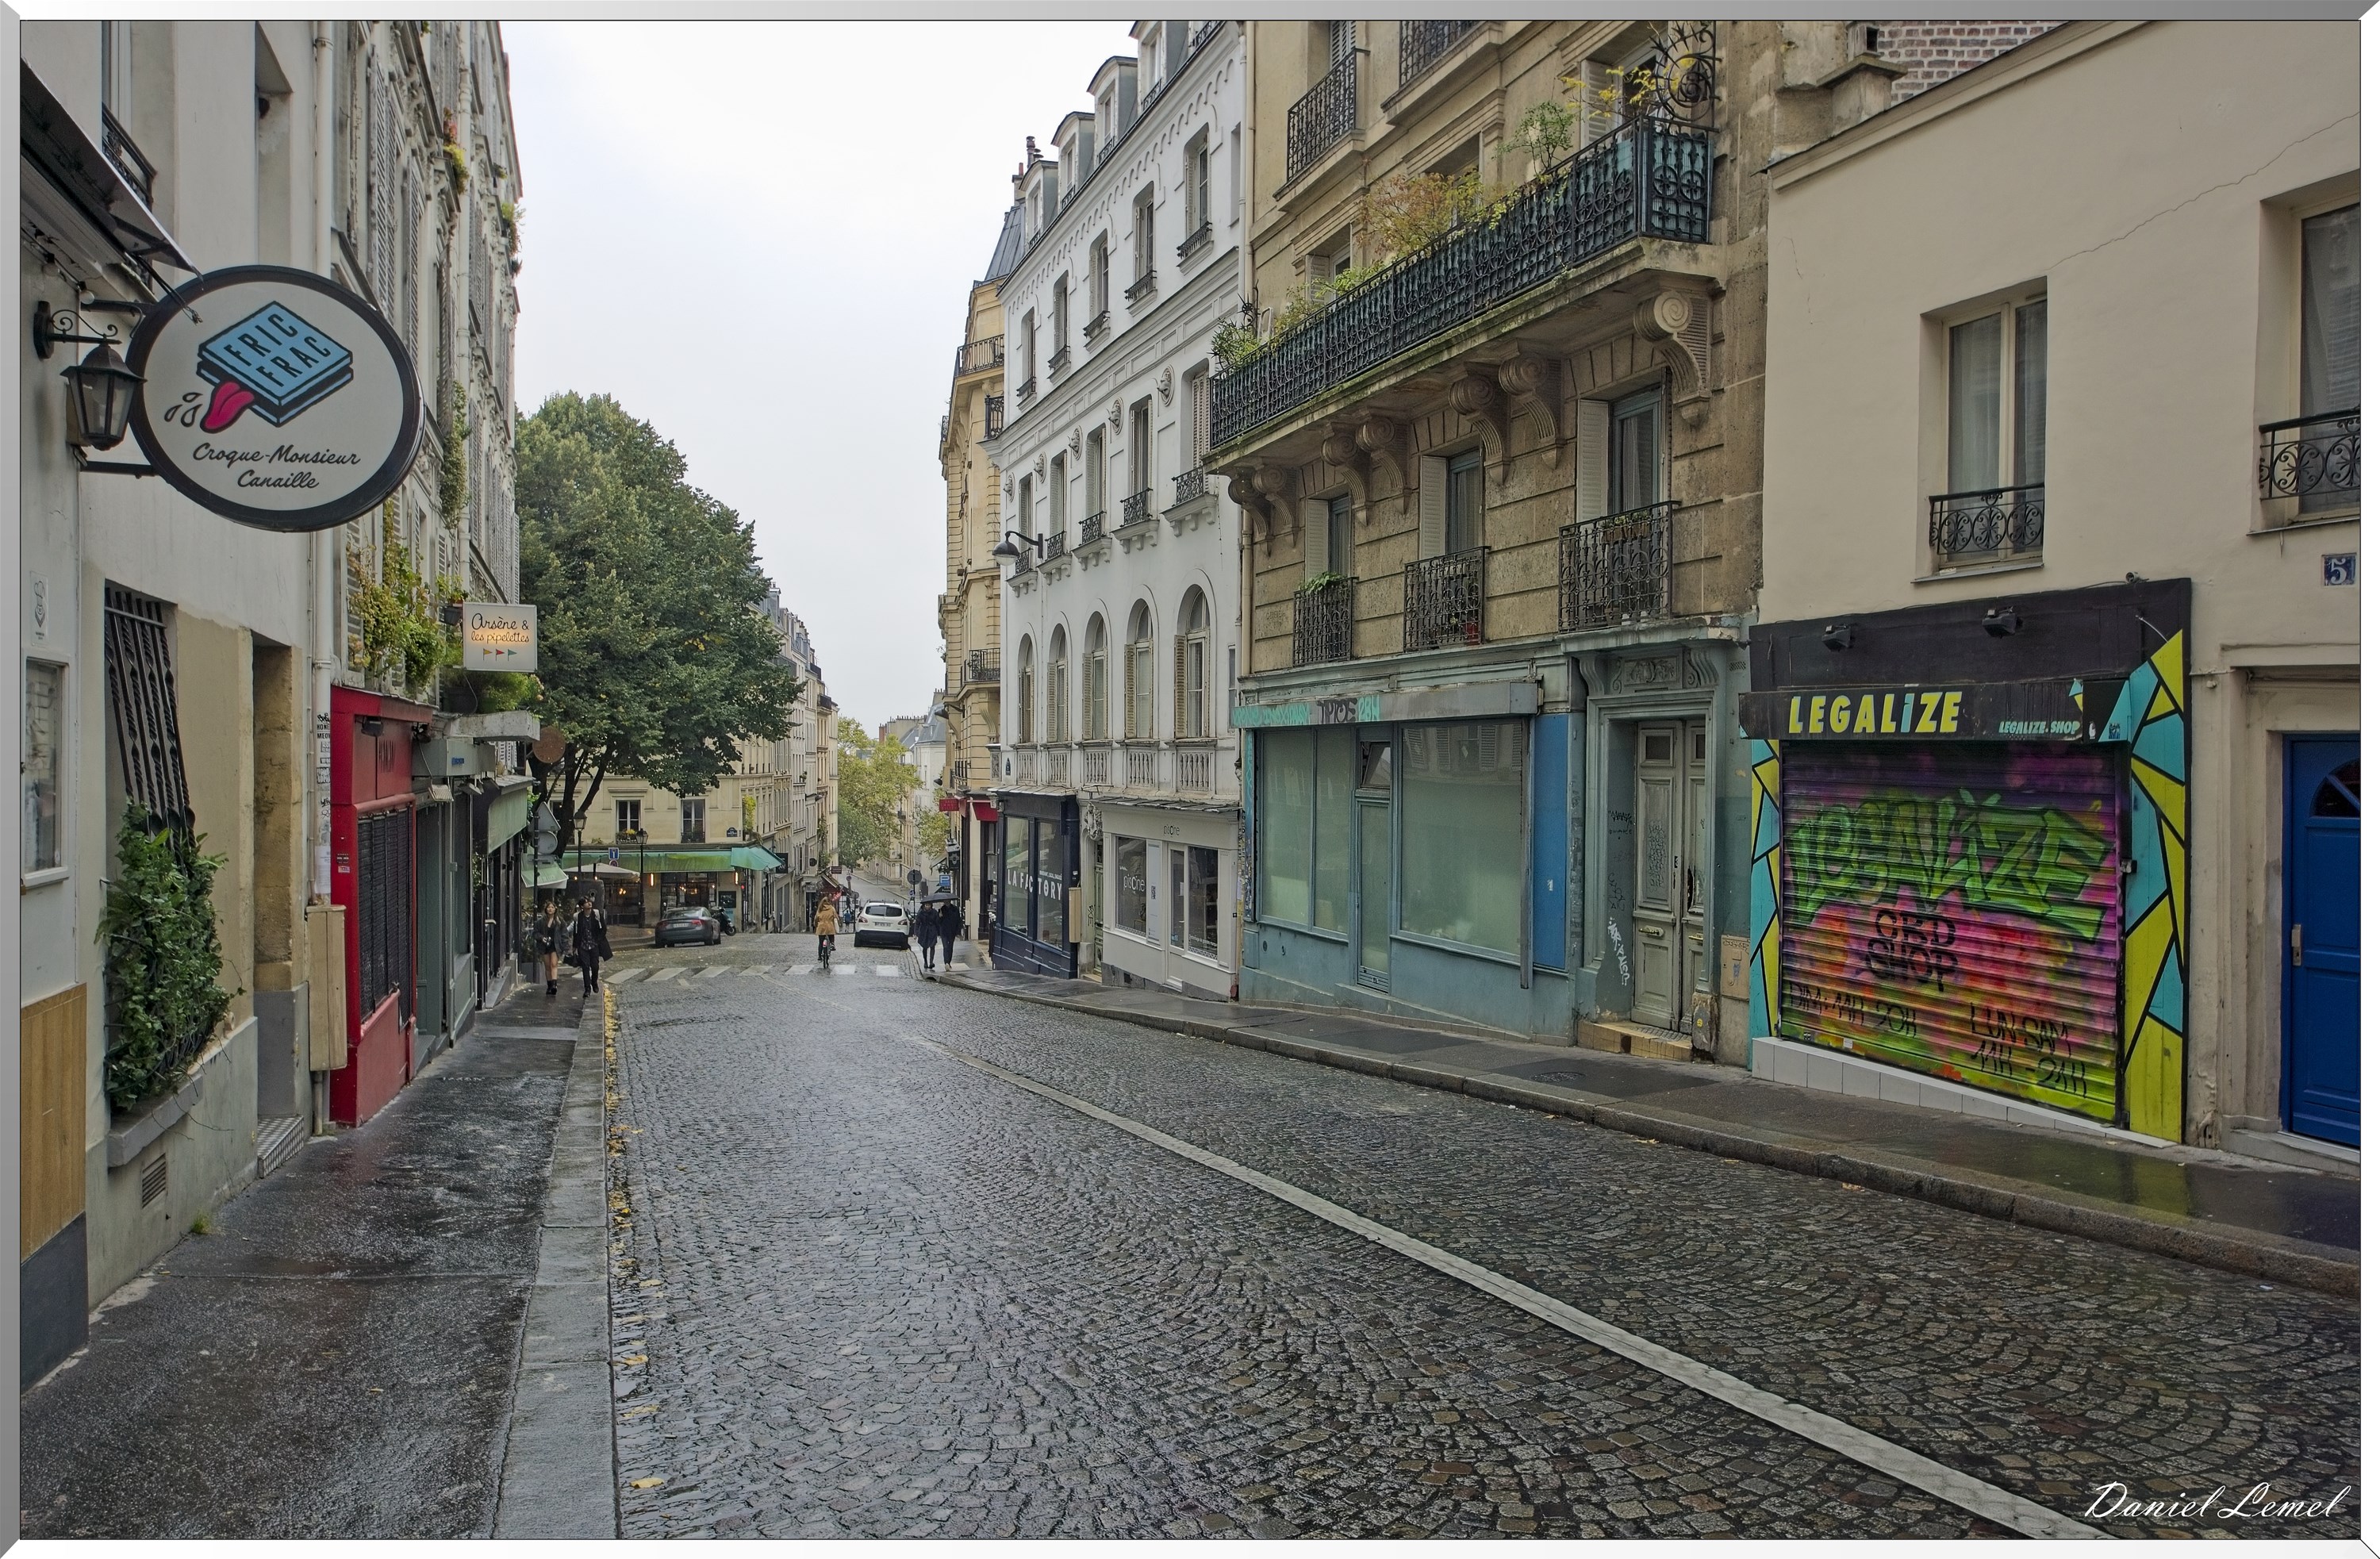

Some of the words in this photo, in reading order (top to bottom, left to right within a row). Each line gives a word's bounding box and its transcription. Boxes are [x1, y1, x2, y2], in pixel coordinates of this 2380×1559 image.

[223, 313, 298, 367] FRIC
[255, 336, 332, 388] FRAC
[192, 442, 362, 469] Croque-Monsieur
[236, 469, 320, 490] Canaille
[2330, 558, 2347, 585] 5
[471, 612, 517, 630] Arsène
[521, 620, 529, 630] &
[470, 631, 485, 641] les
[486, 632, 530, 644] pipelettes
[1008, 869, 1017, 886] LA
